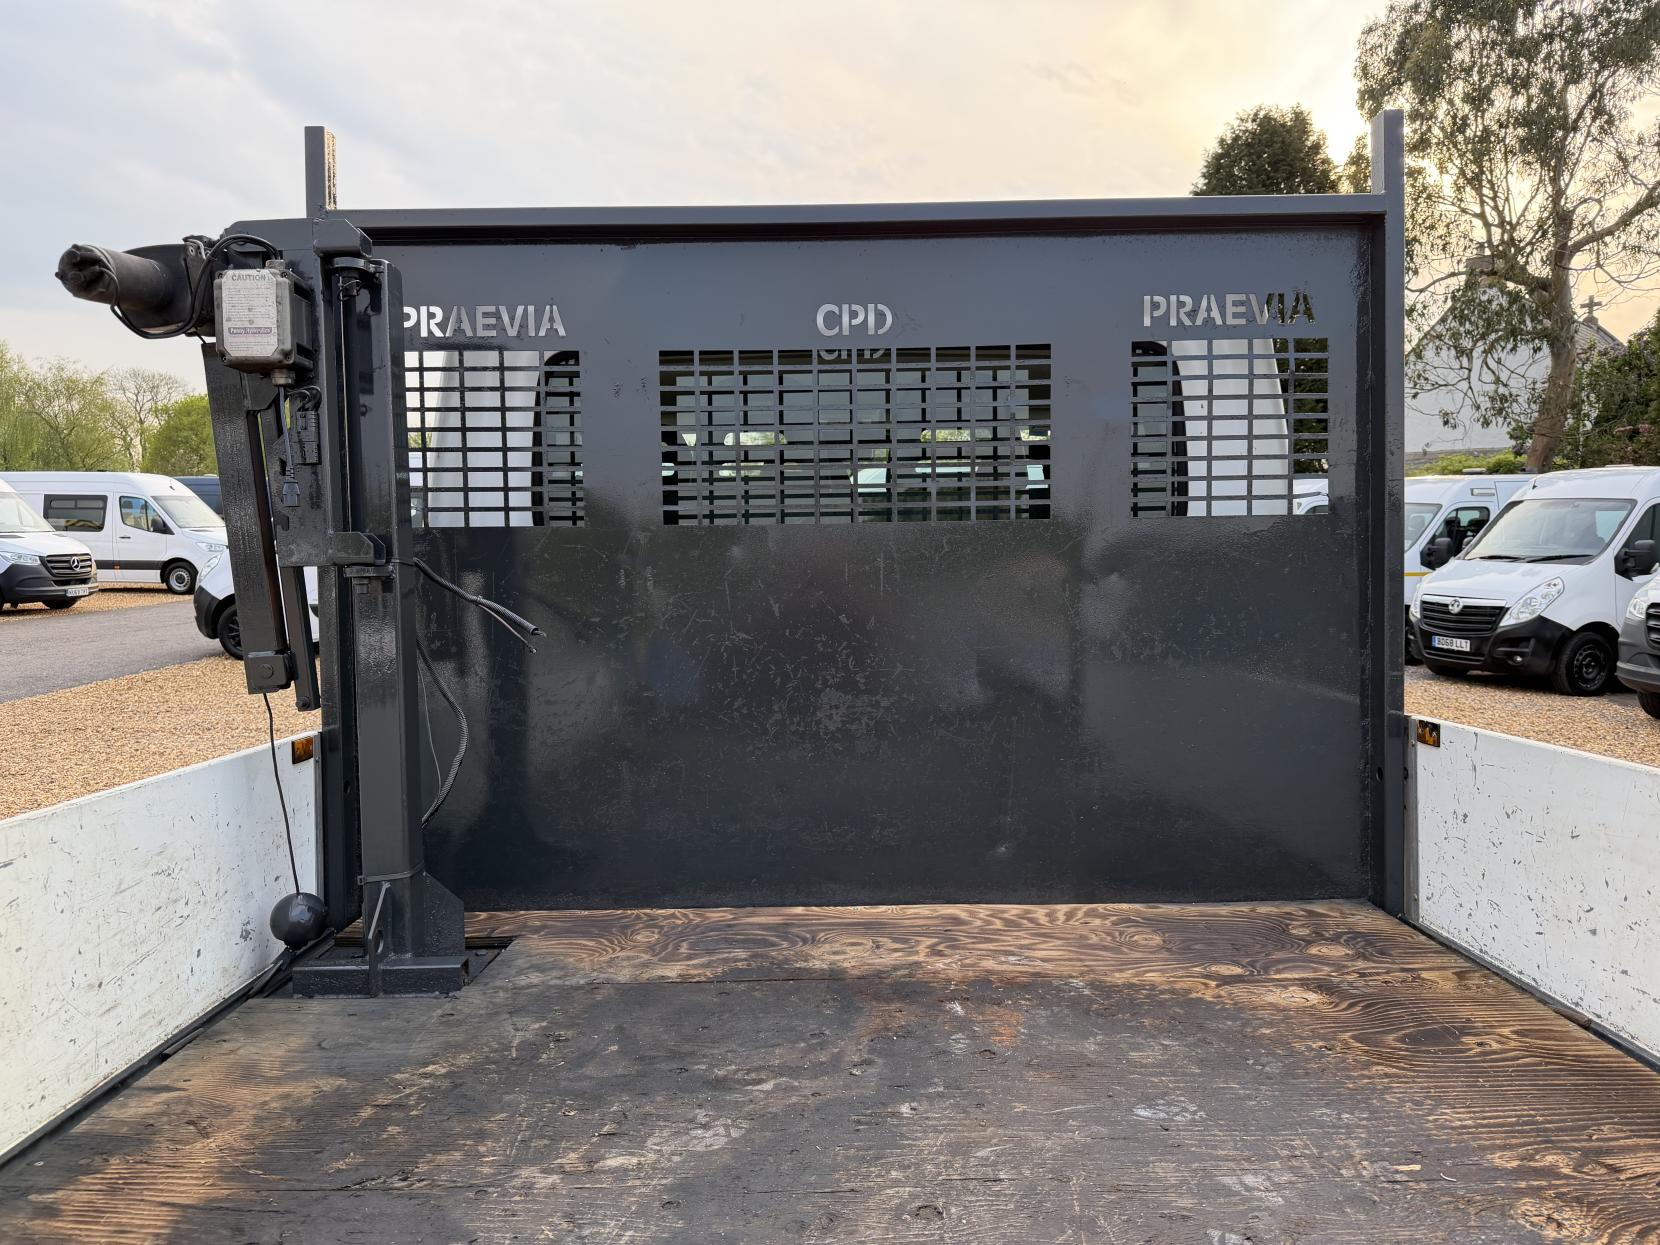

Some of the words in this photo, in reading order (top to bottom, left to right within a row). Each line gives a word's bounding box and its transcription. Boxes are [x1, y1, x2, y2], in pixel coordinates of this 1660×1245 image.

[231, 273, 266, 281] CAUTION
[403, 304, 567, 338] PRAEVIA
[816, 303, 893, 337] CPD
[1143, 292, 1316, 327] PRAEVIA
